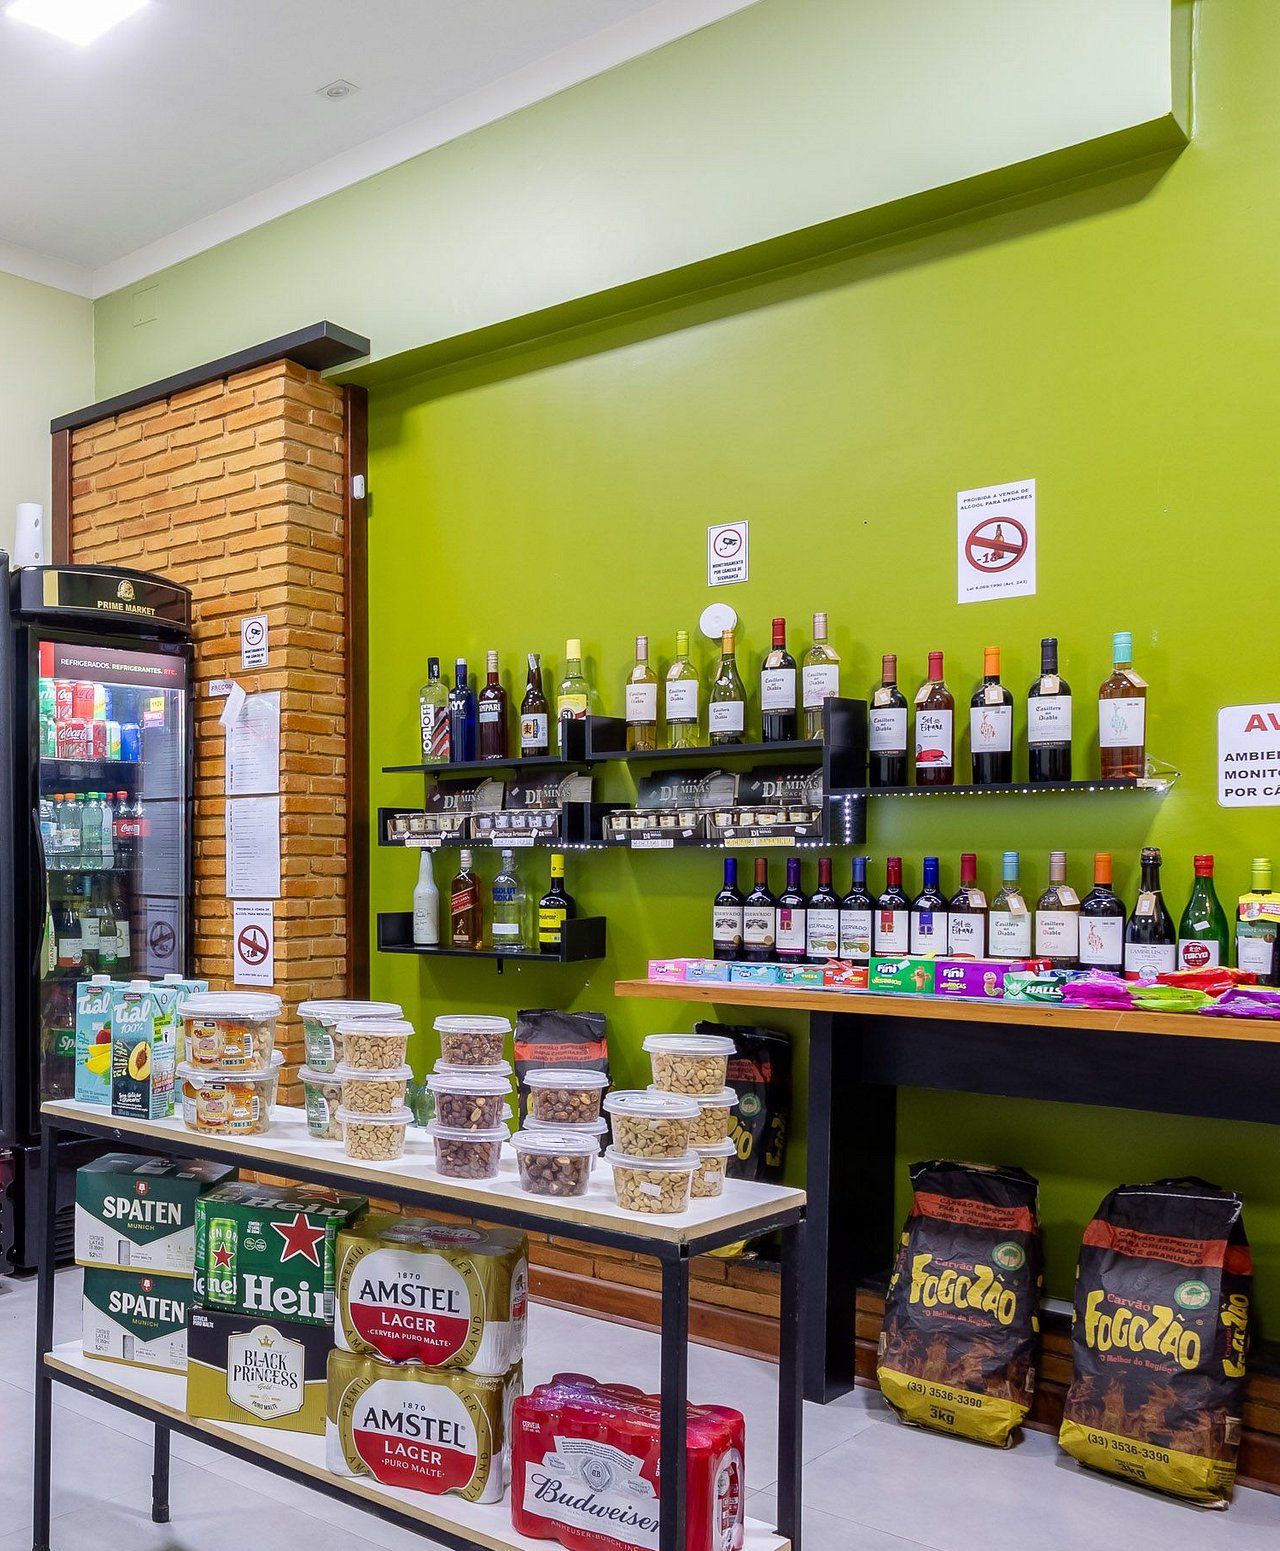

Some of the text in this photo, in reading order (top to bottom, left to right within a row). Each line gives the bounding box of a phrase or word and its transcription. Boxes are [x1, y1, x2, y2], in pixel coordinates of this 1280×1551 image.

[1003, 494, 1033, 502] MENORES
[97, 600, 155, 615] PRIME MARKET
[1225, 769, 1280, 779] MONIT
[1225, 788, 1257, 797] POR
[877, 964, 898, 974] Fini
[942, 969, 964, 979] Fini
[1026, 985, 1062, 996] HALLS
[78, 992, 110, 1015] Tial
[114, 999, 151, 1023] Tial
[121, 1023, 144, 1033] 100%
[102, 1195, 182, 1225] SPATEN
[128, 1222, 155, 1231] MUNICH
[935, 1258, 972, 1271] Carvão
[398, 1272, 421, 1280] 1870
[358, 1279, 460, 1313] AMSTEL
[1106, 1293, 1151, 1312] Carvão
[108, 1290, 184, 1324] SPATEN
[132, 1318, 159, 1328] MUNICH
[381, 1311, 436, 1333] LAGER
[402, 1333, 422, 1342] PURO
[244, 1350, 287, 1371] BLACK
[907, 1381, 982, 1408] (33) 3536-3390
[402, 1402, 426, 1412] 1870
[930, 1407, 955, 1425] 3kg
[362, 1407, 466, 1449] AMSTEL
[384, 1441, 442, 1466] LAGER
[1087, 1433, 1170, 1464] (33) 3536-3390
[384, 1458, 442, 1478] PURO MALTE
